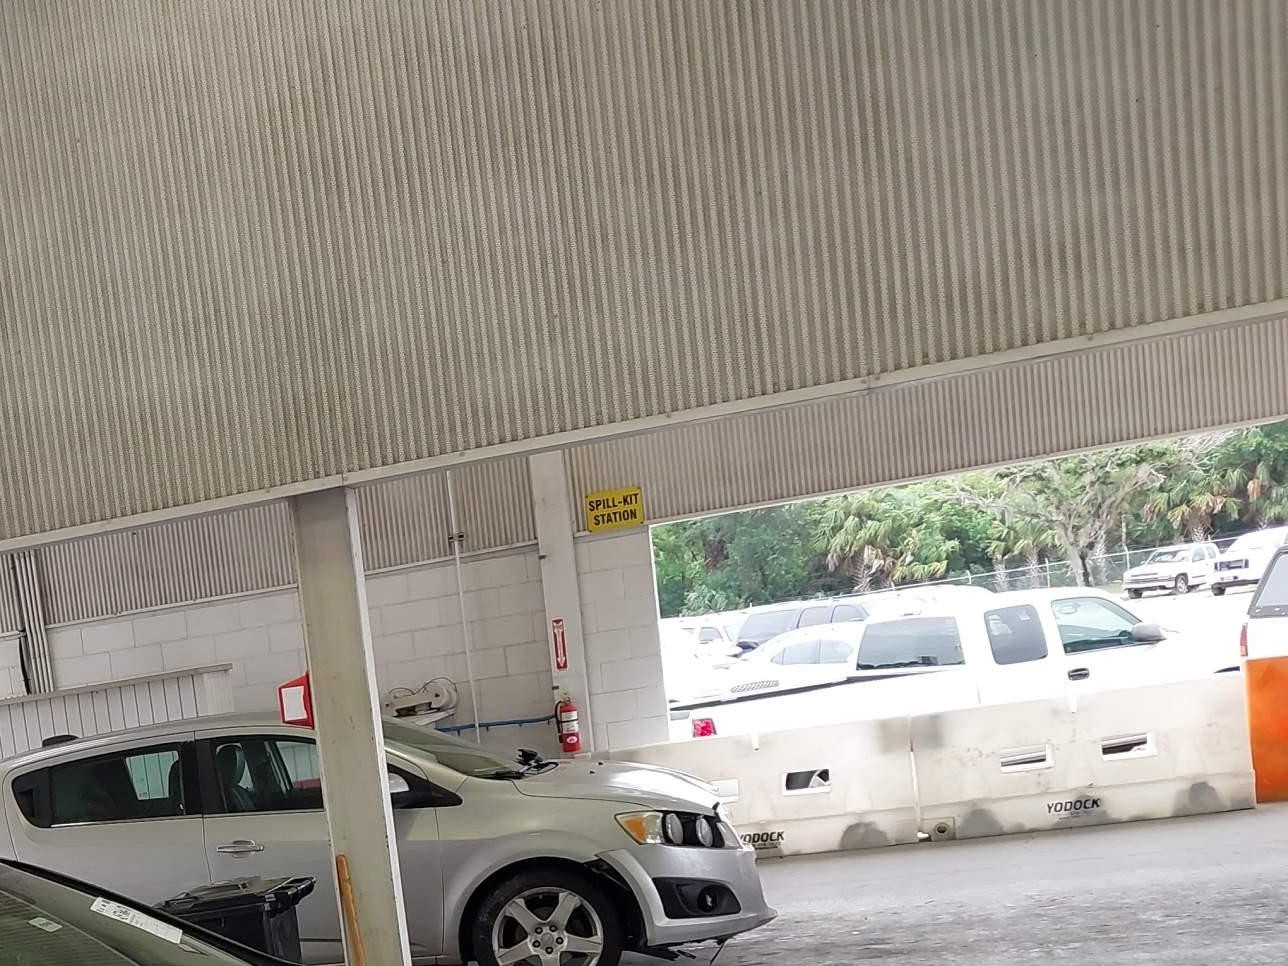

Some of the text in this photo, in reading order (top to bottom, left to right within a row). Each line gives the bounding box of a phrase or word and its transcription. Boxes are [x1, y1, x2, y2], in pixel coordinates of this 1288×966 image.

[588, 493, 639, 512] SPILL-KIT
[593, 508, 637, 526] STATION
[1047, 798, 1100, 814] YODOCK
